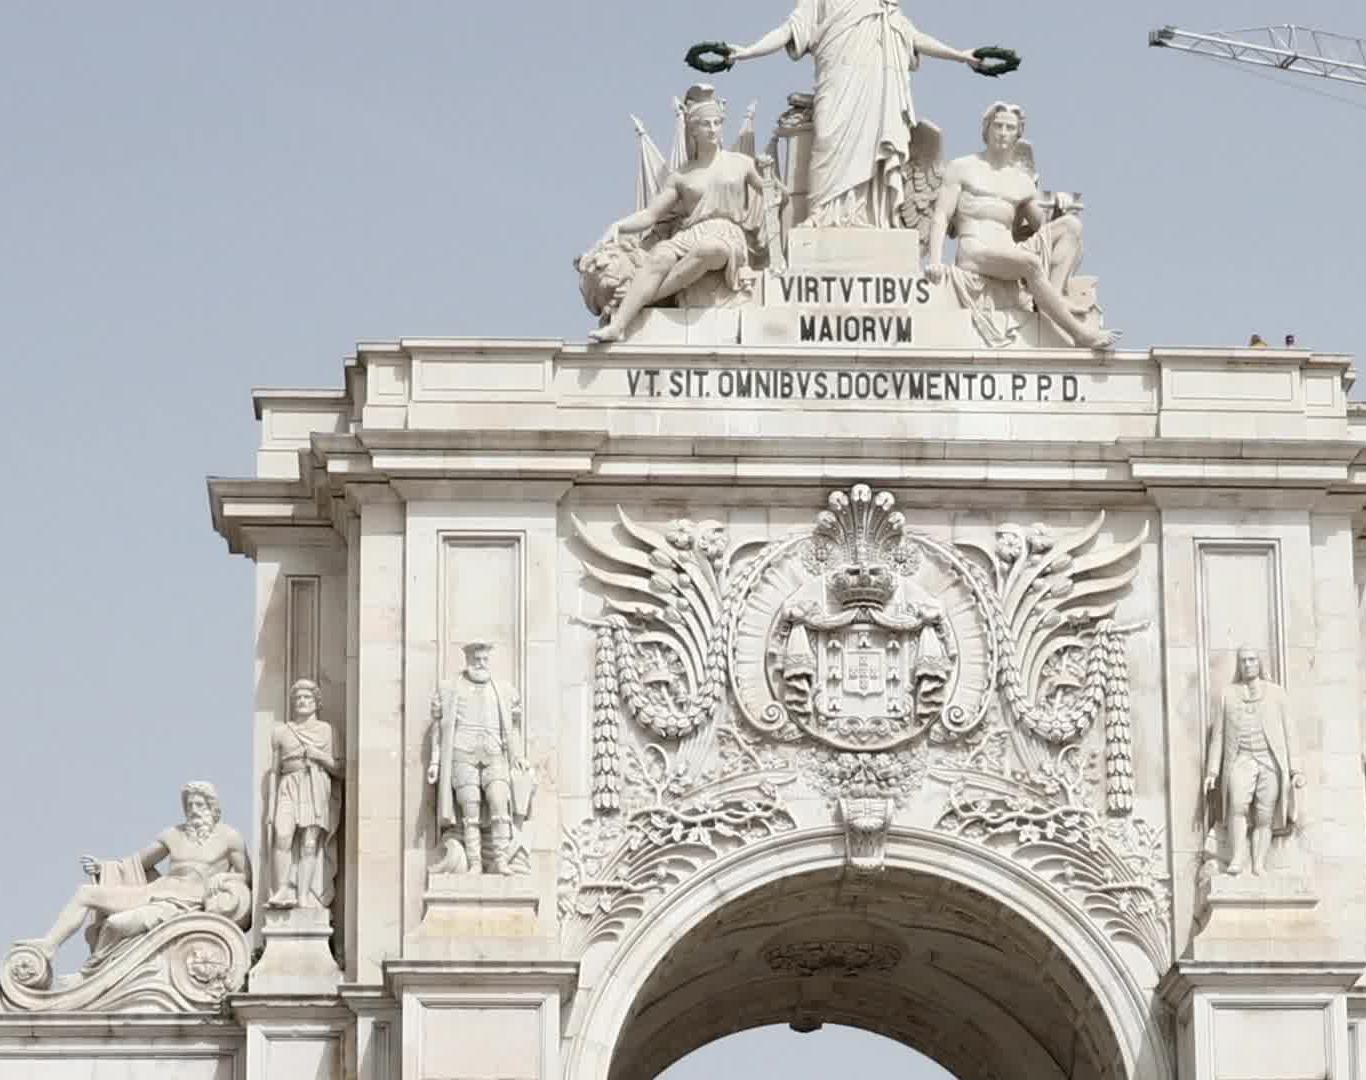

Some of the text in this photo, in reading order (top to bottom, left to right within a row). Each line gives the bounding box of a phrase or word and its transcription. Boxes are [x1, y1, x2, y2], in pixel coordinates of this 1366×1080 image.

[779, 276, 930, 304] VIRTVTIBVS
[800, 315, 912, 342] MAIORVM
[627, 370, 662, 397] VT.
[669, 371, 710, 398] SIT.
[1062, 375, 1086, 402] D.
